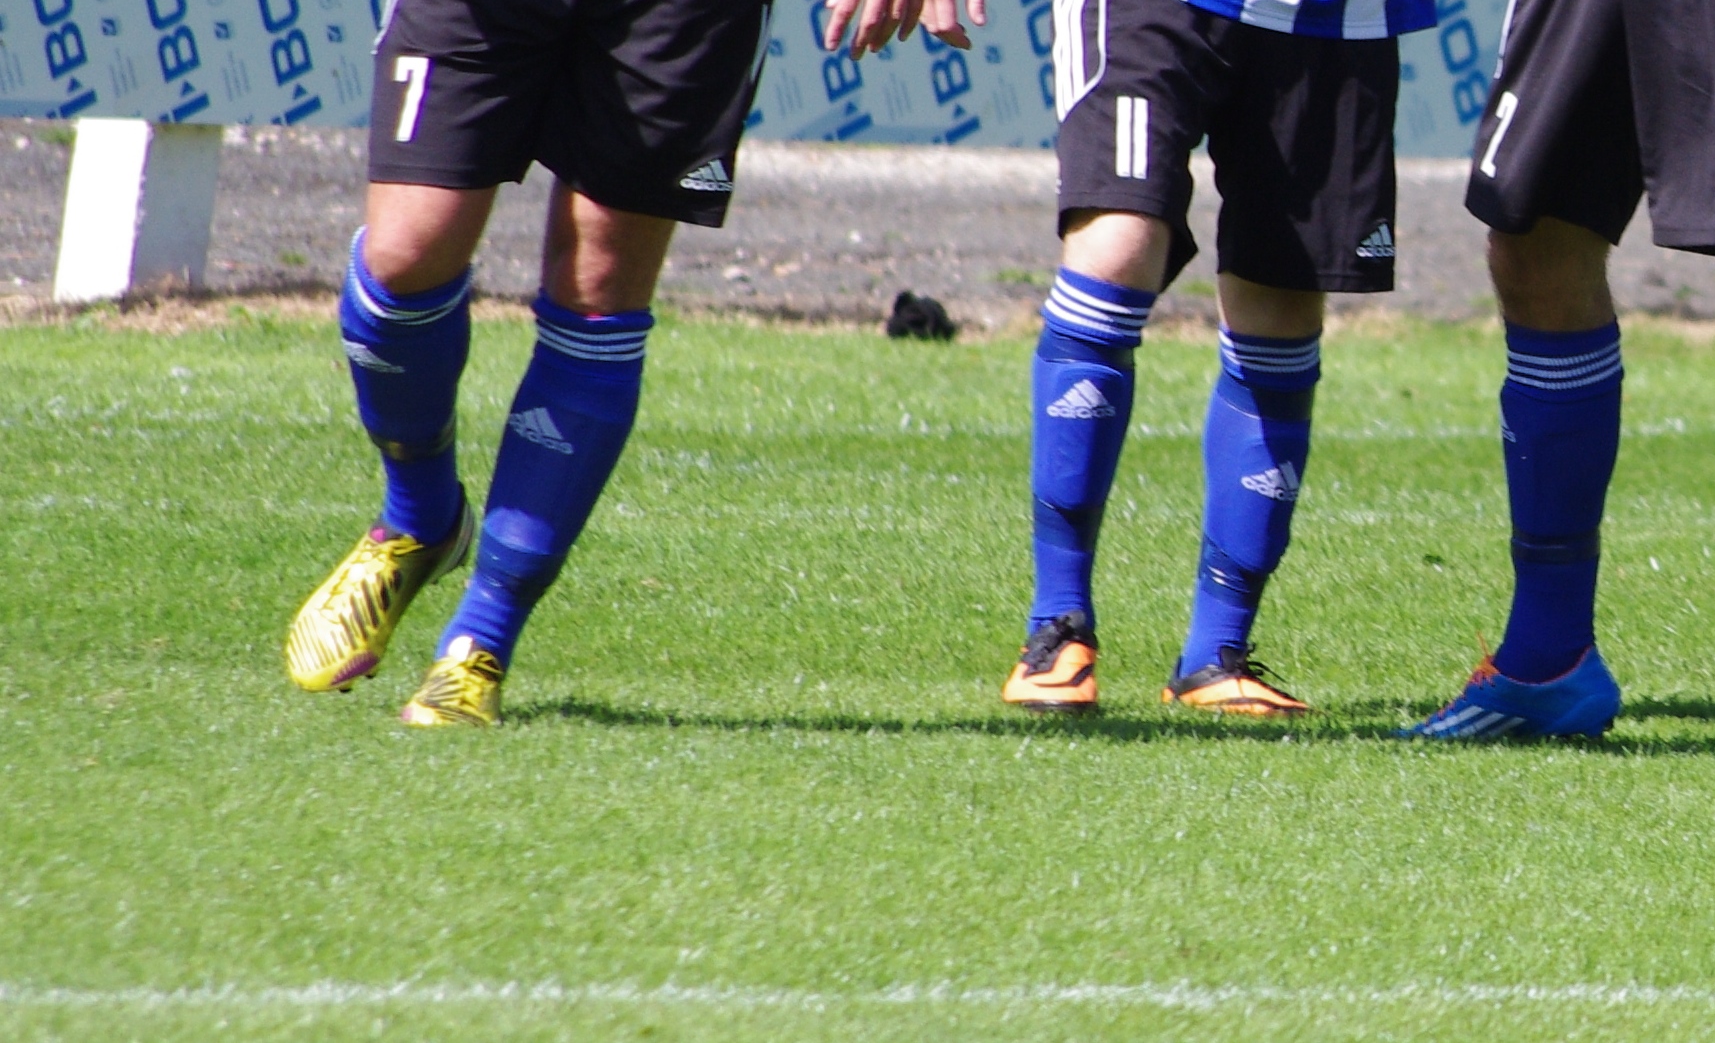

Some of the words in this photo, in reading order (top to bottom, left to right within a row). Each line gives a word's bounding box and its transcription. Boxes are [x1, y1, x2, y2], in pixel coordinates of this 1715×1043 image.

[393, 56, 430, 142] 7
[1115, 95, 1149, 180] 11
[1046, 405, 1115, 419] adidas
